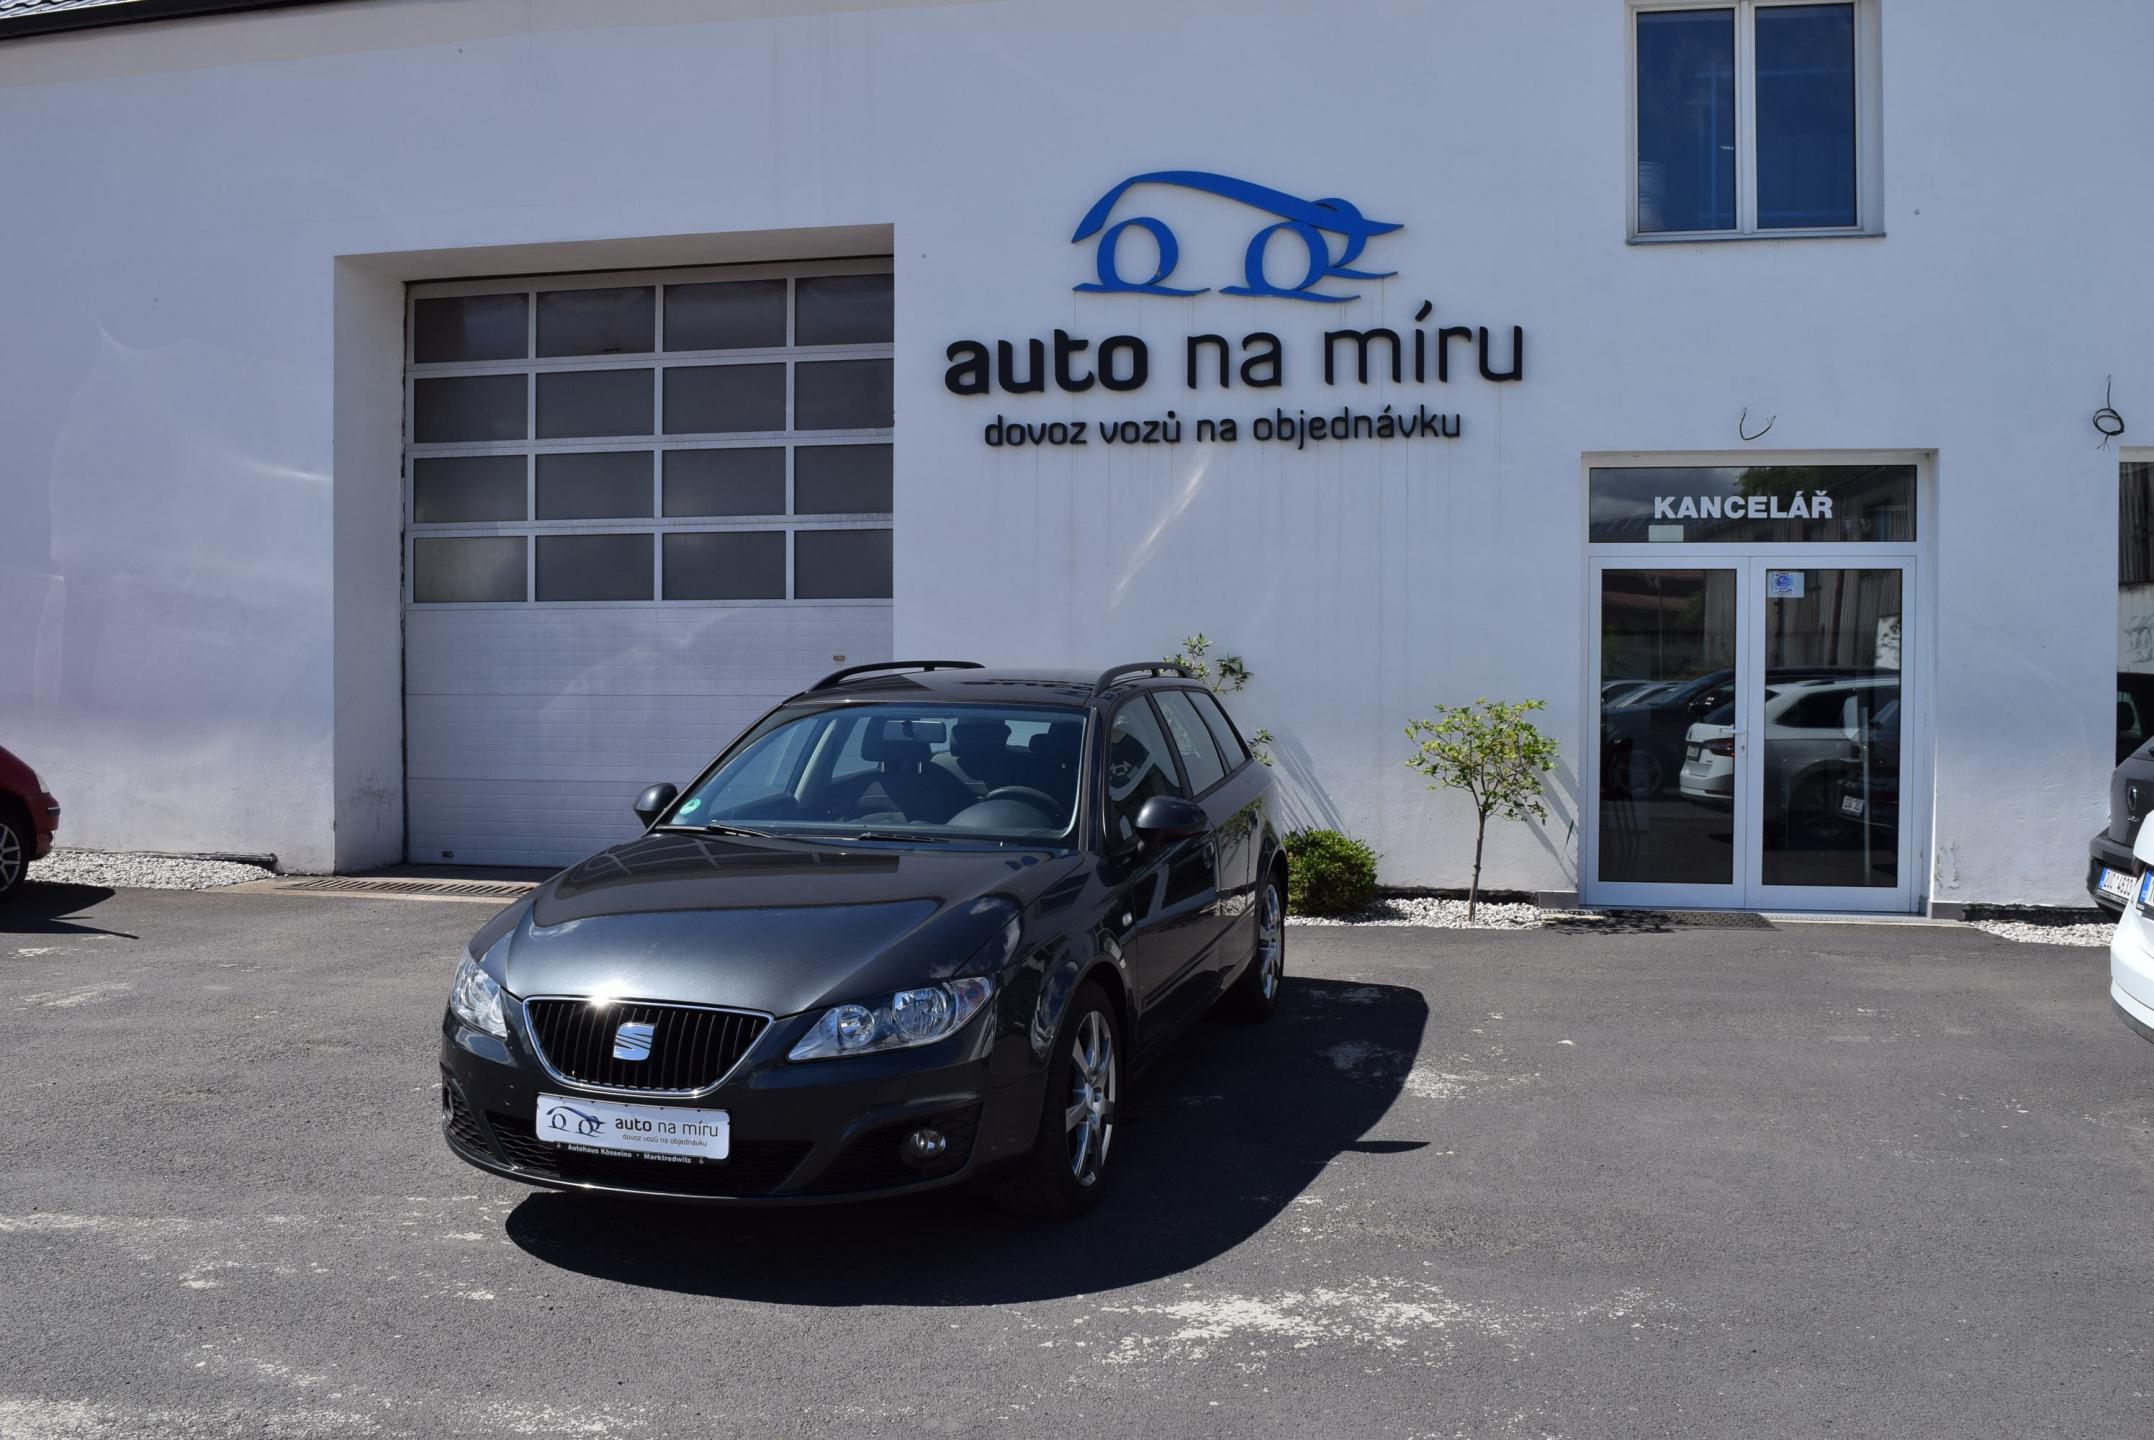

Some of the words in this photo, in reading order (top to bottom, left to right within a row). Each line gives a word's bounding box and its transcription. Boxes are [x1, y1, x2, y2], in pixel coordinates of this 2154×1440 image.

[945, 329, 1149, 395] auto
[1187, 332, 1282, 390] na
[1324, 300, 1523, 385] míru
[984, 415, 1087, 447] dovoz
[1100, 411, 1181, 444] vozů
[1197, 417, 1238, 442] na
[1253, 404, 1462, 450] objednávku
[1654, 490, 1832, 519] KANCELÁŘ
[615, 1117, 652, 1132] auto
[658, 1121, 676, 1134] na
[682, 1120, 719, 1137] míru
[568, 1144, 599, 1154] Autohaus
[622, 1133, 641, 1142] dovoz
[643, 1135, 659, 1143] vozů
[670, 1138, 708, 1148] objednávku
